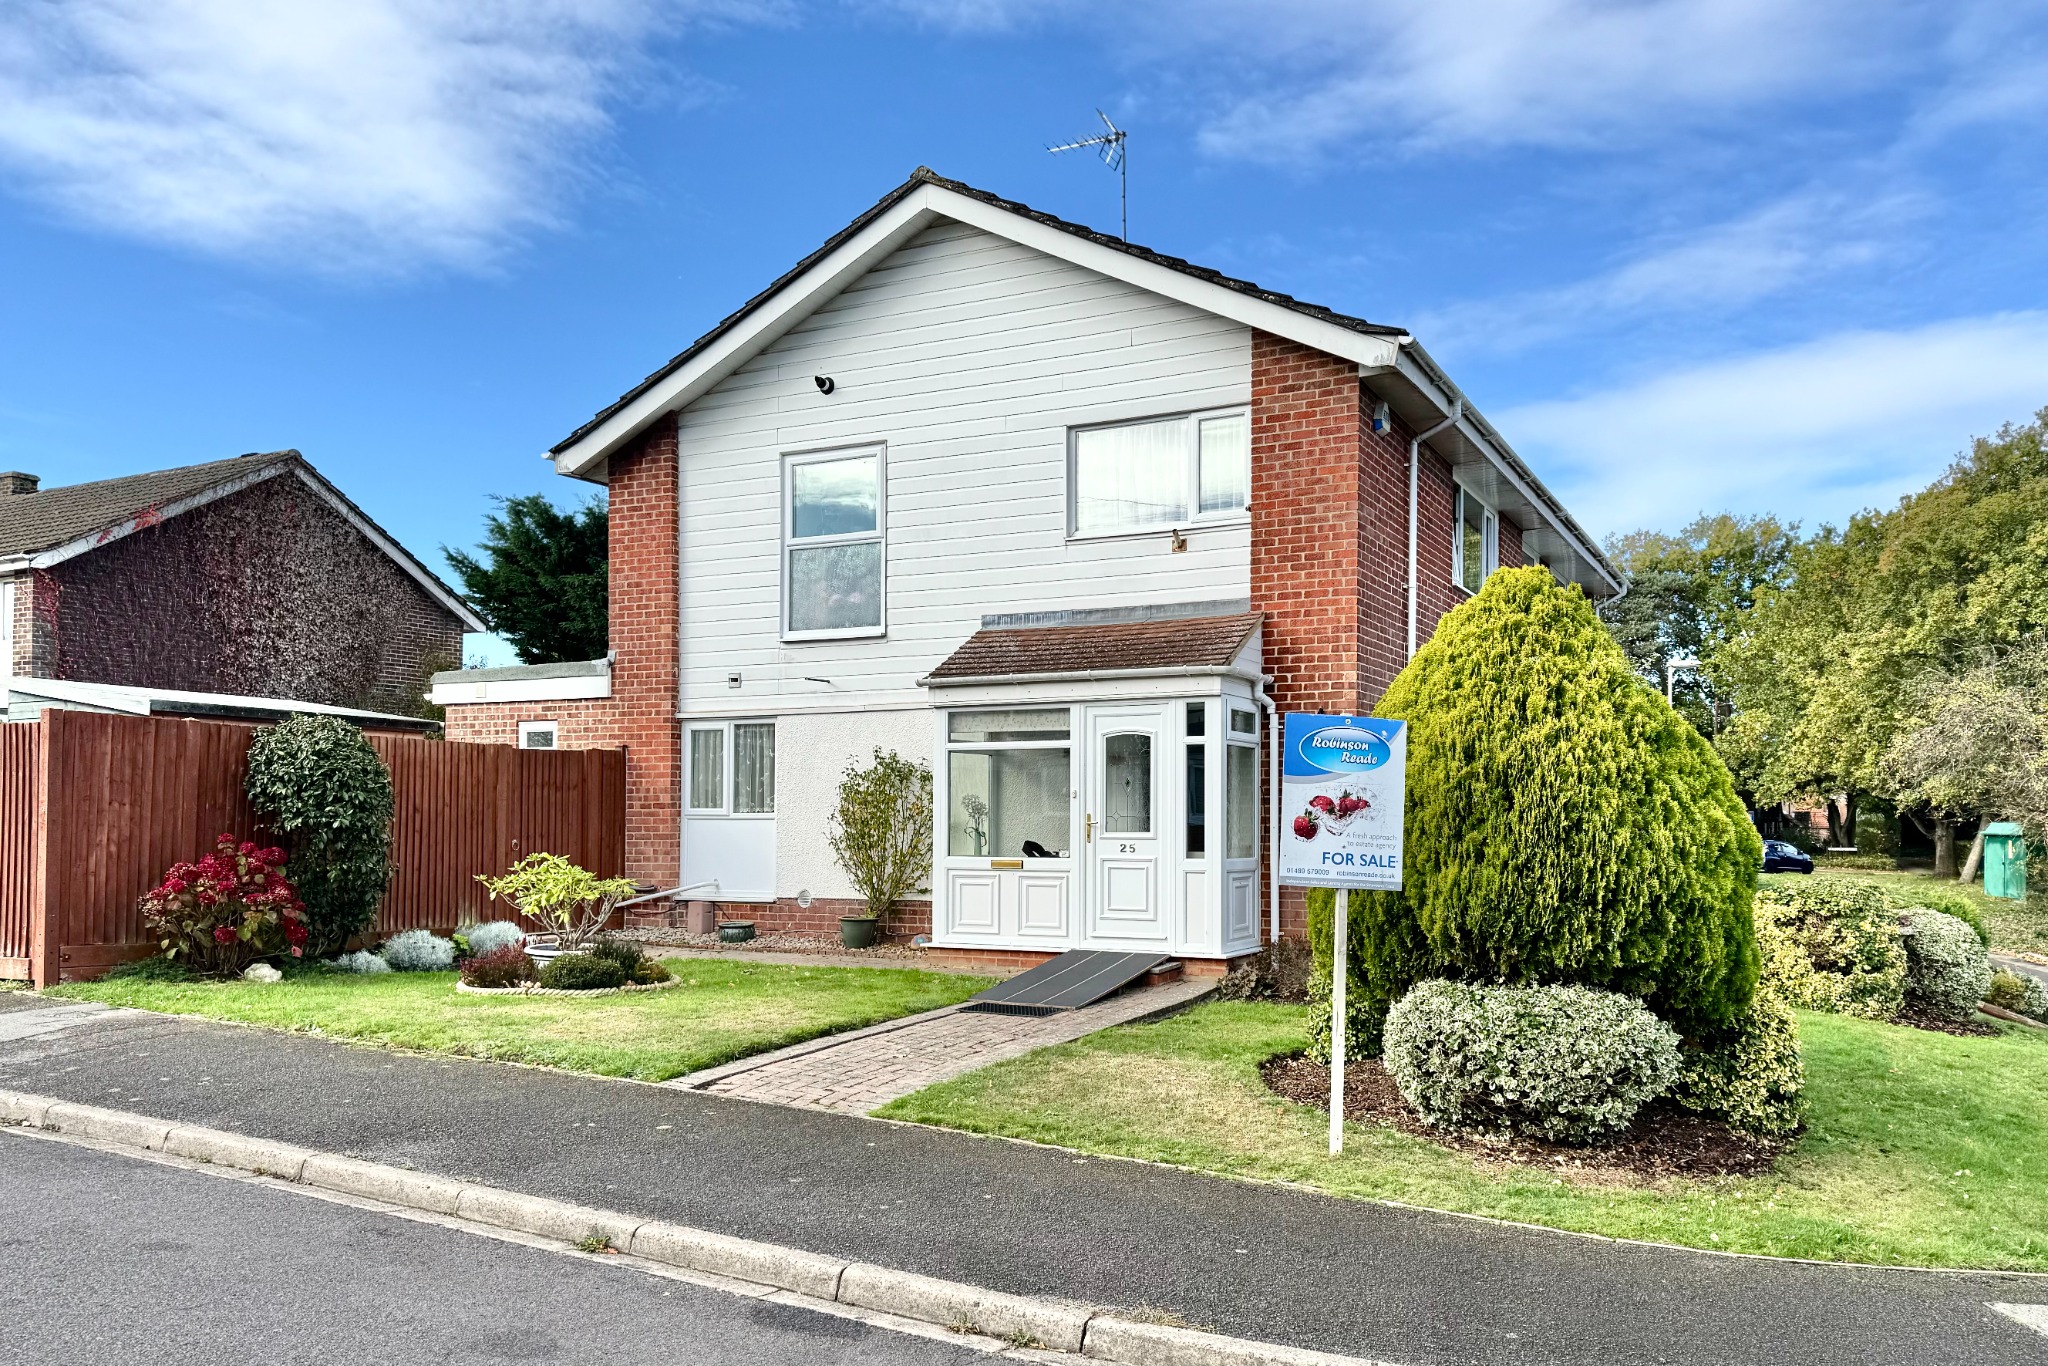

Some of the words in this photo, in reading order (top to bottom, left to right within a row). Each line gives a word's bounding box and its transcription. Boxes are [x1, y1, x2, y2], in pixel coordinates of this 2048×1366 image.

[1312, 736, 1369, 751] Robinson
[1341, 751, 1378, 765] Reade
[1119, 843, 1136, 853] 25
[1322, 851, 1355, 866] FOR
[1359, 854, 1396, 868] SALE
